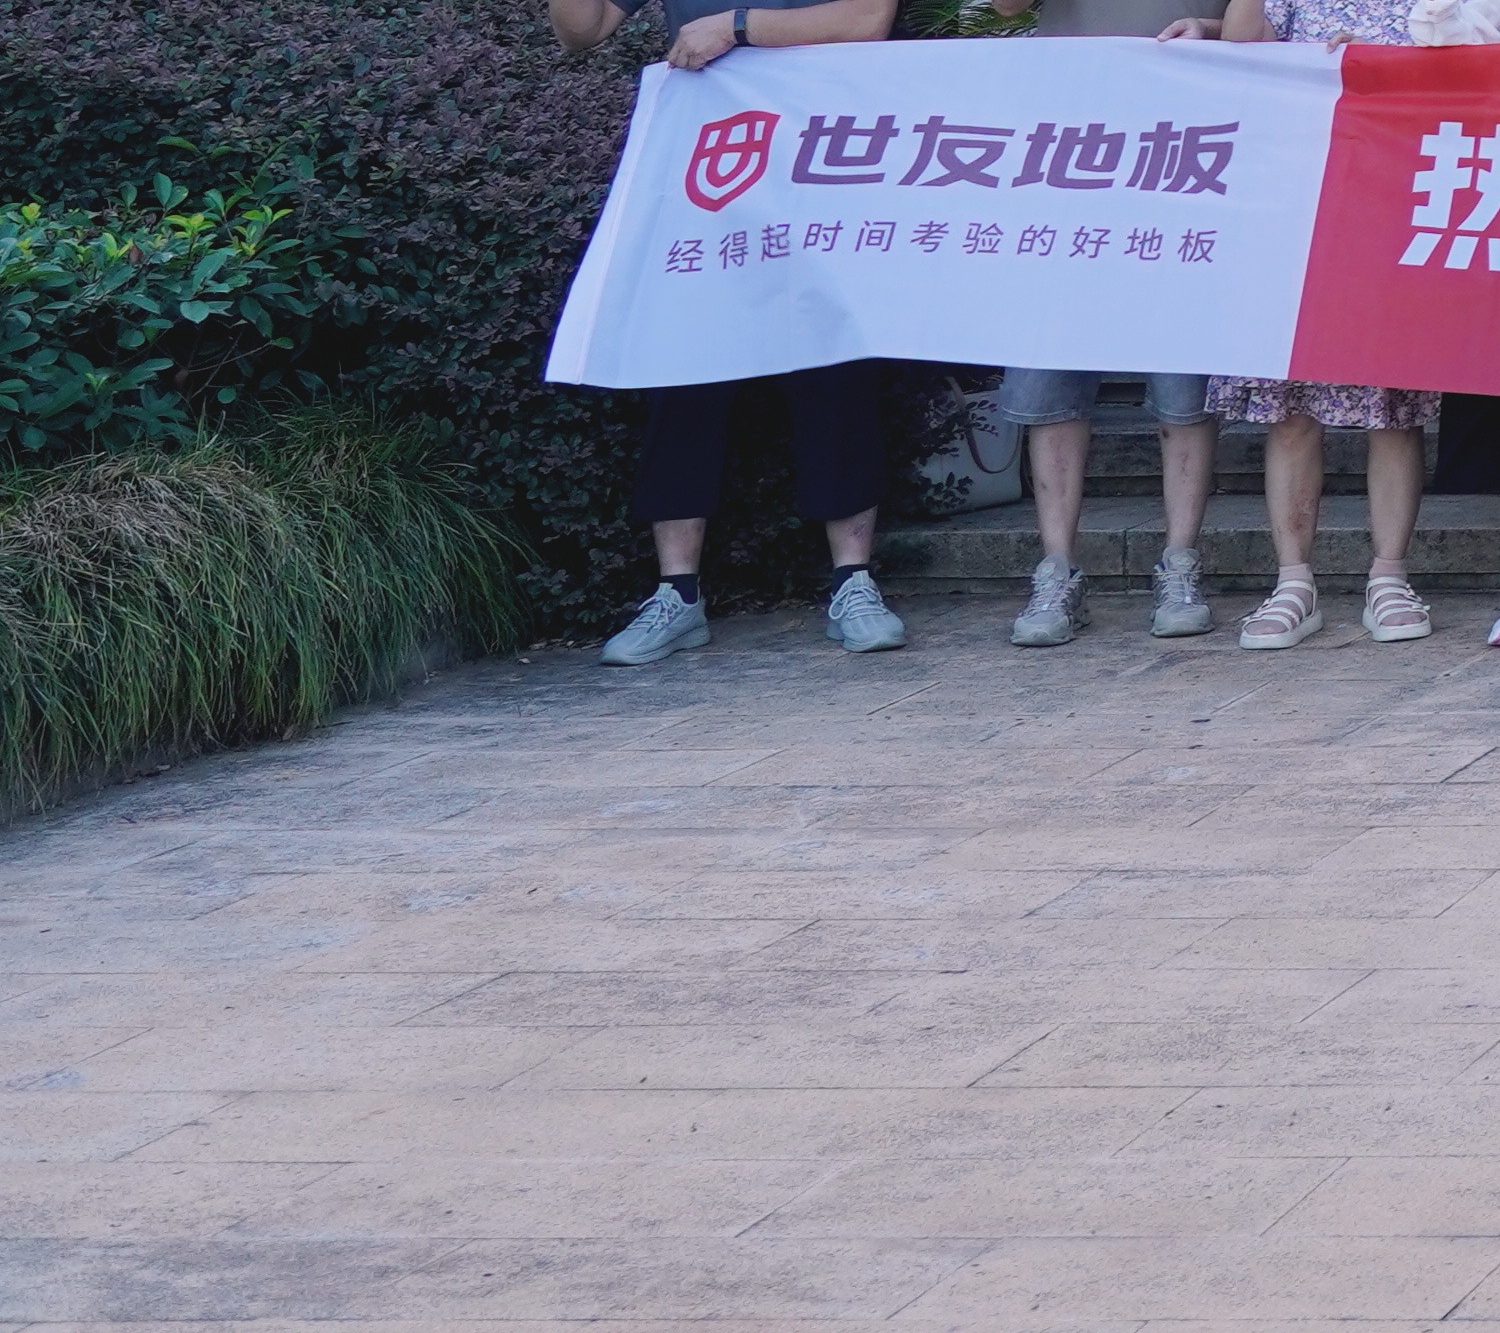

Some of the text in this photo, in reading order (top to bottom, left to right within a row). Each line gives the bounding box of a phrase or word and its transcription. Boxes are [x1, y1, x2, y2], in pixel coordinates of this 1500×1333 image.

[790, 114, 1240, 196] 世友地板
[664, 220, 1219, 274] 经得起时间考验的好地板
